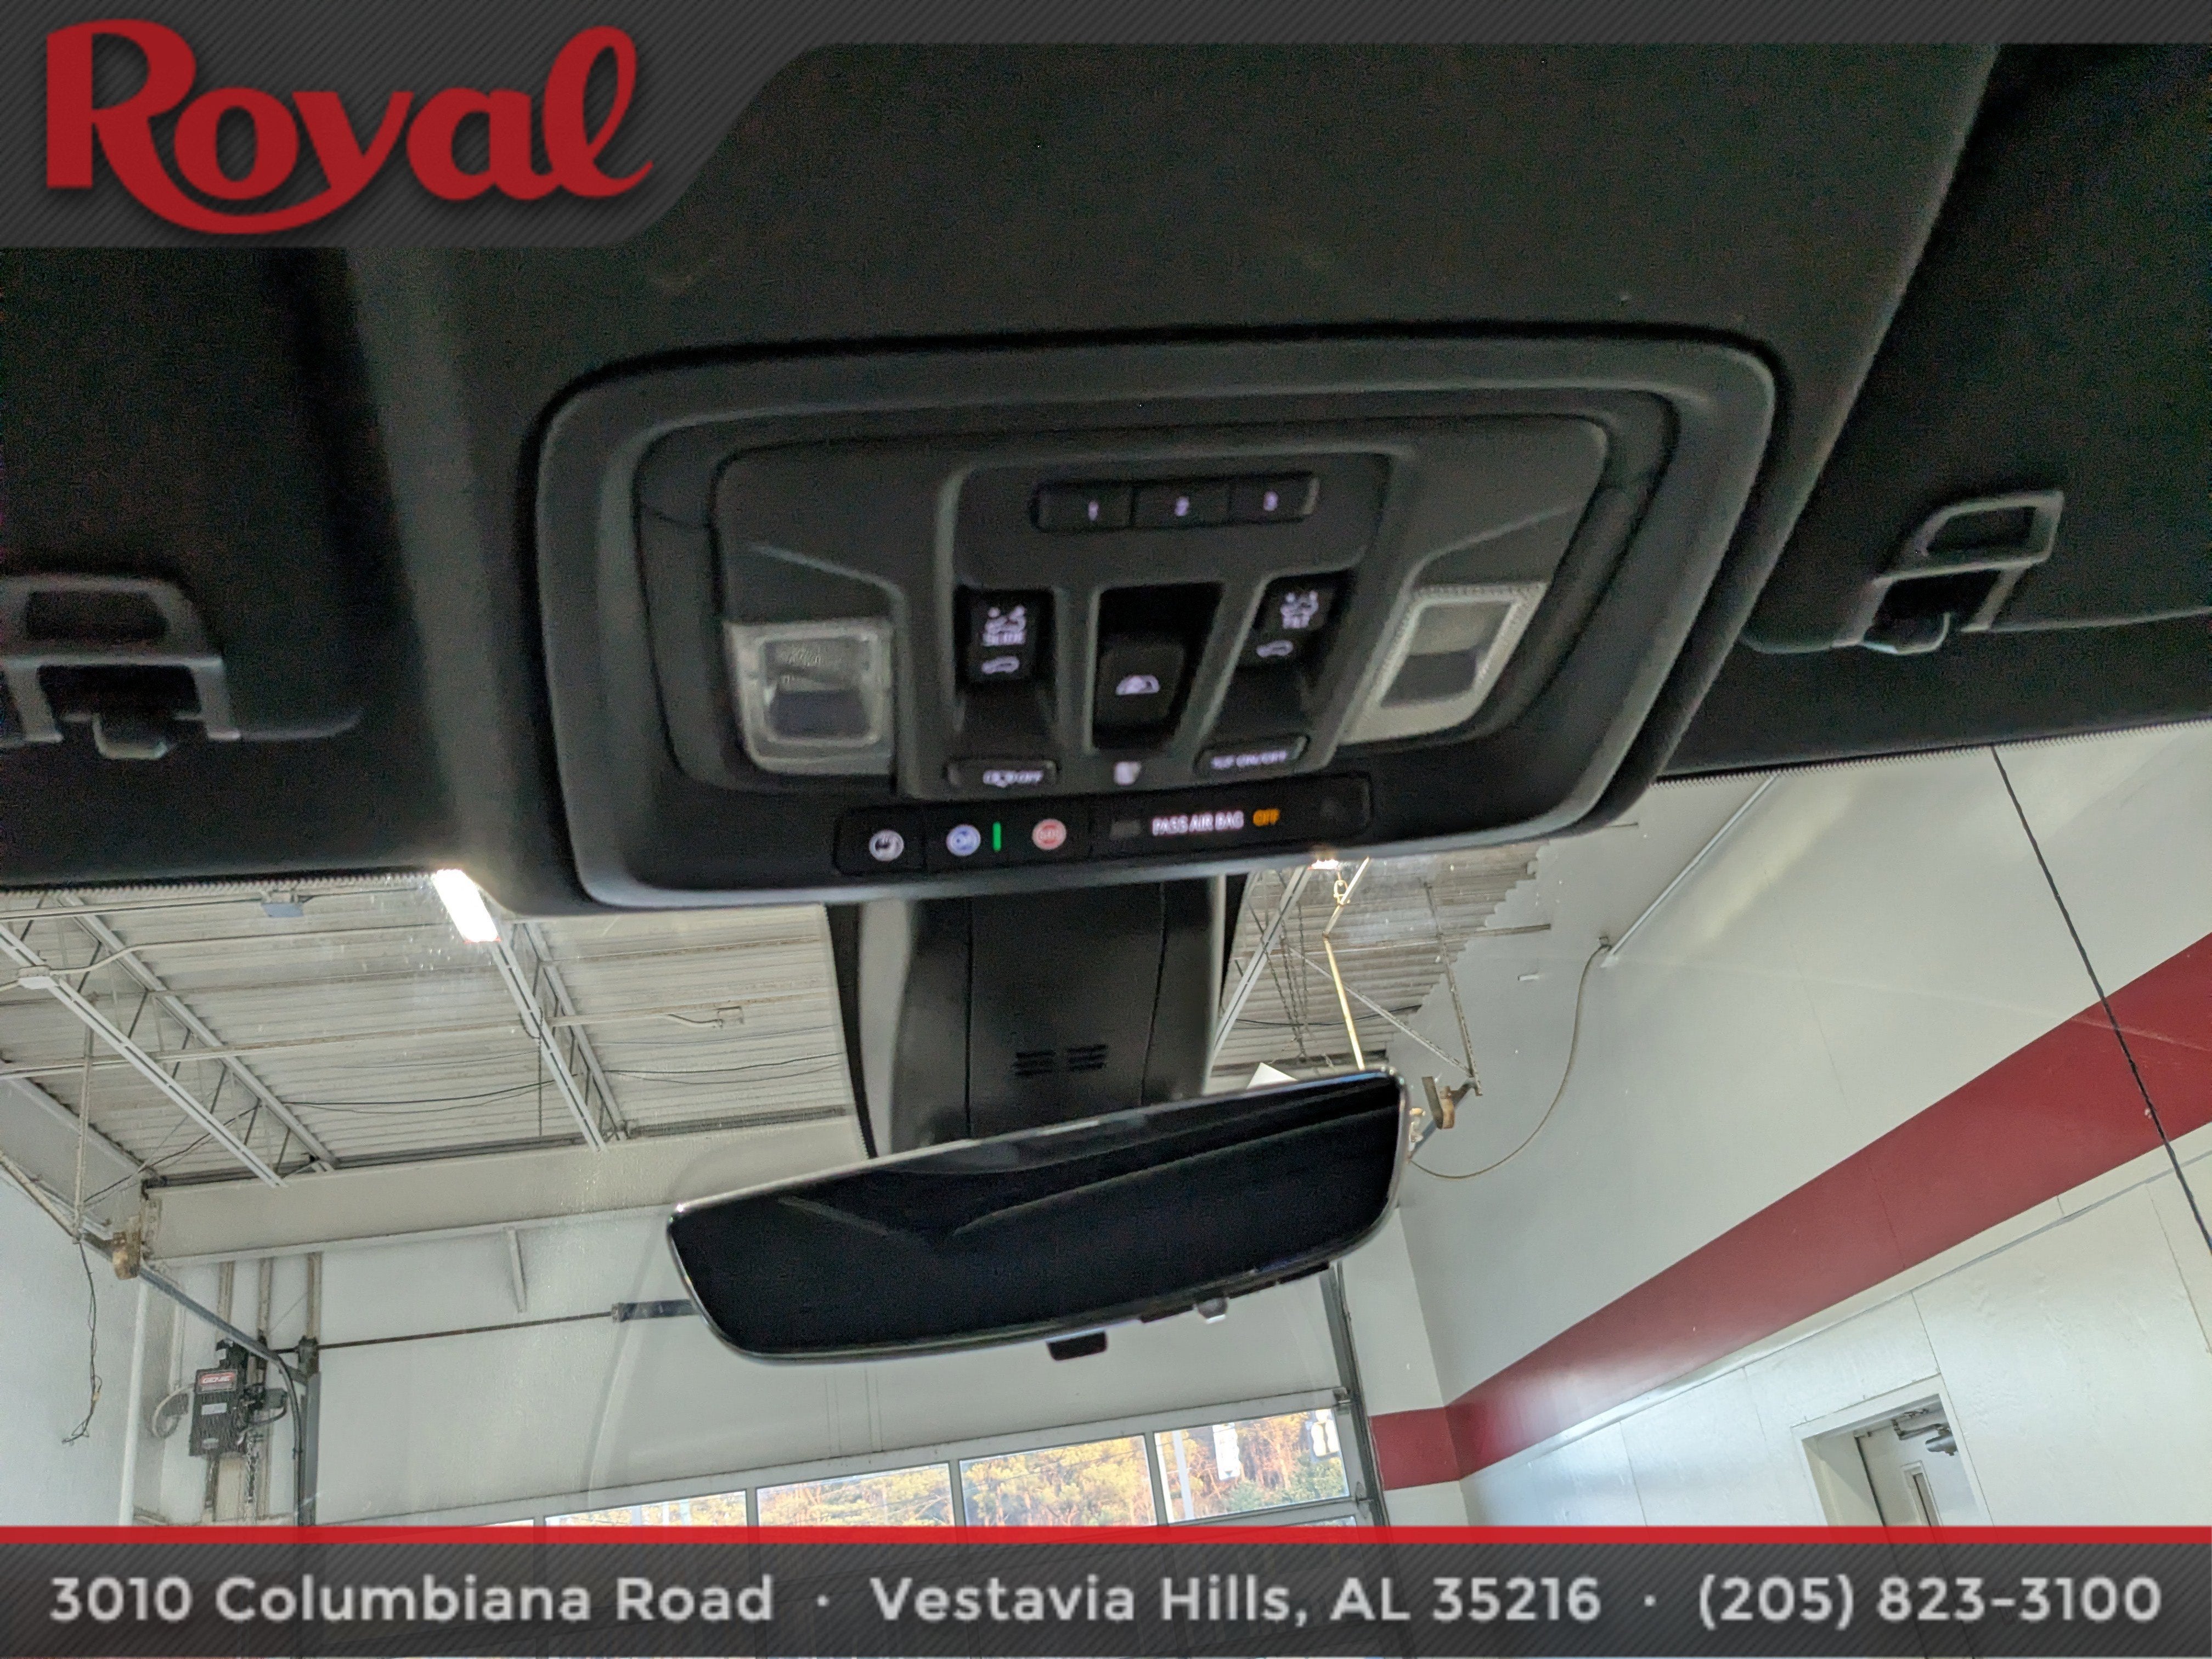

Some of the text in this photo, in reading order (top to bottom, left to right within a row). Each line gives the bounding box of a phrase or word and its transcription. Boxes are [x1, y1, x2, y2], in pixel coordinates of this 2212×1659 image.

[1152, 808, 1280, 836] PASS AIR BAG OFF
